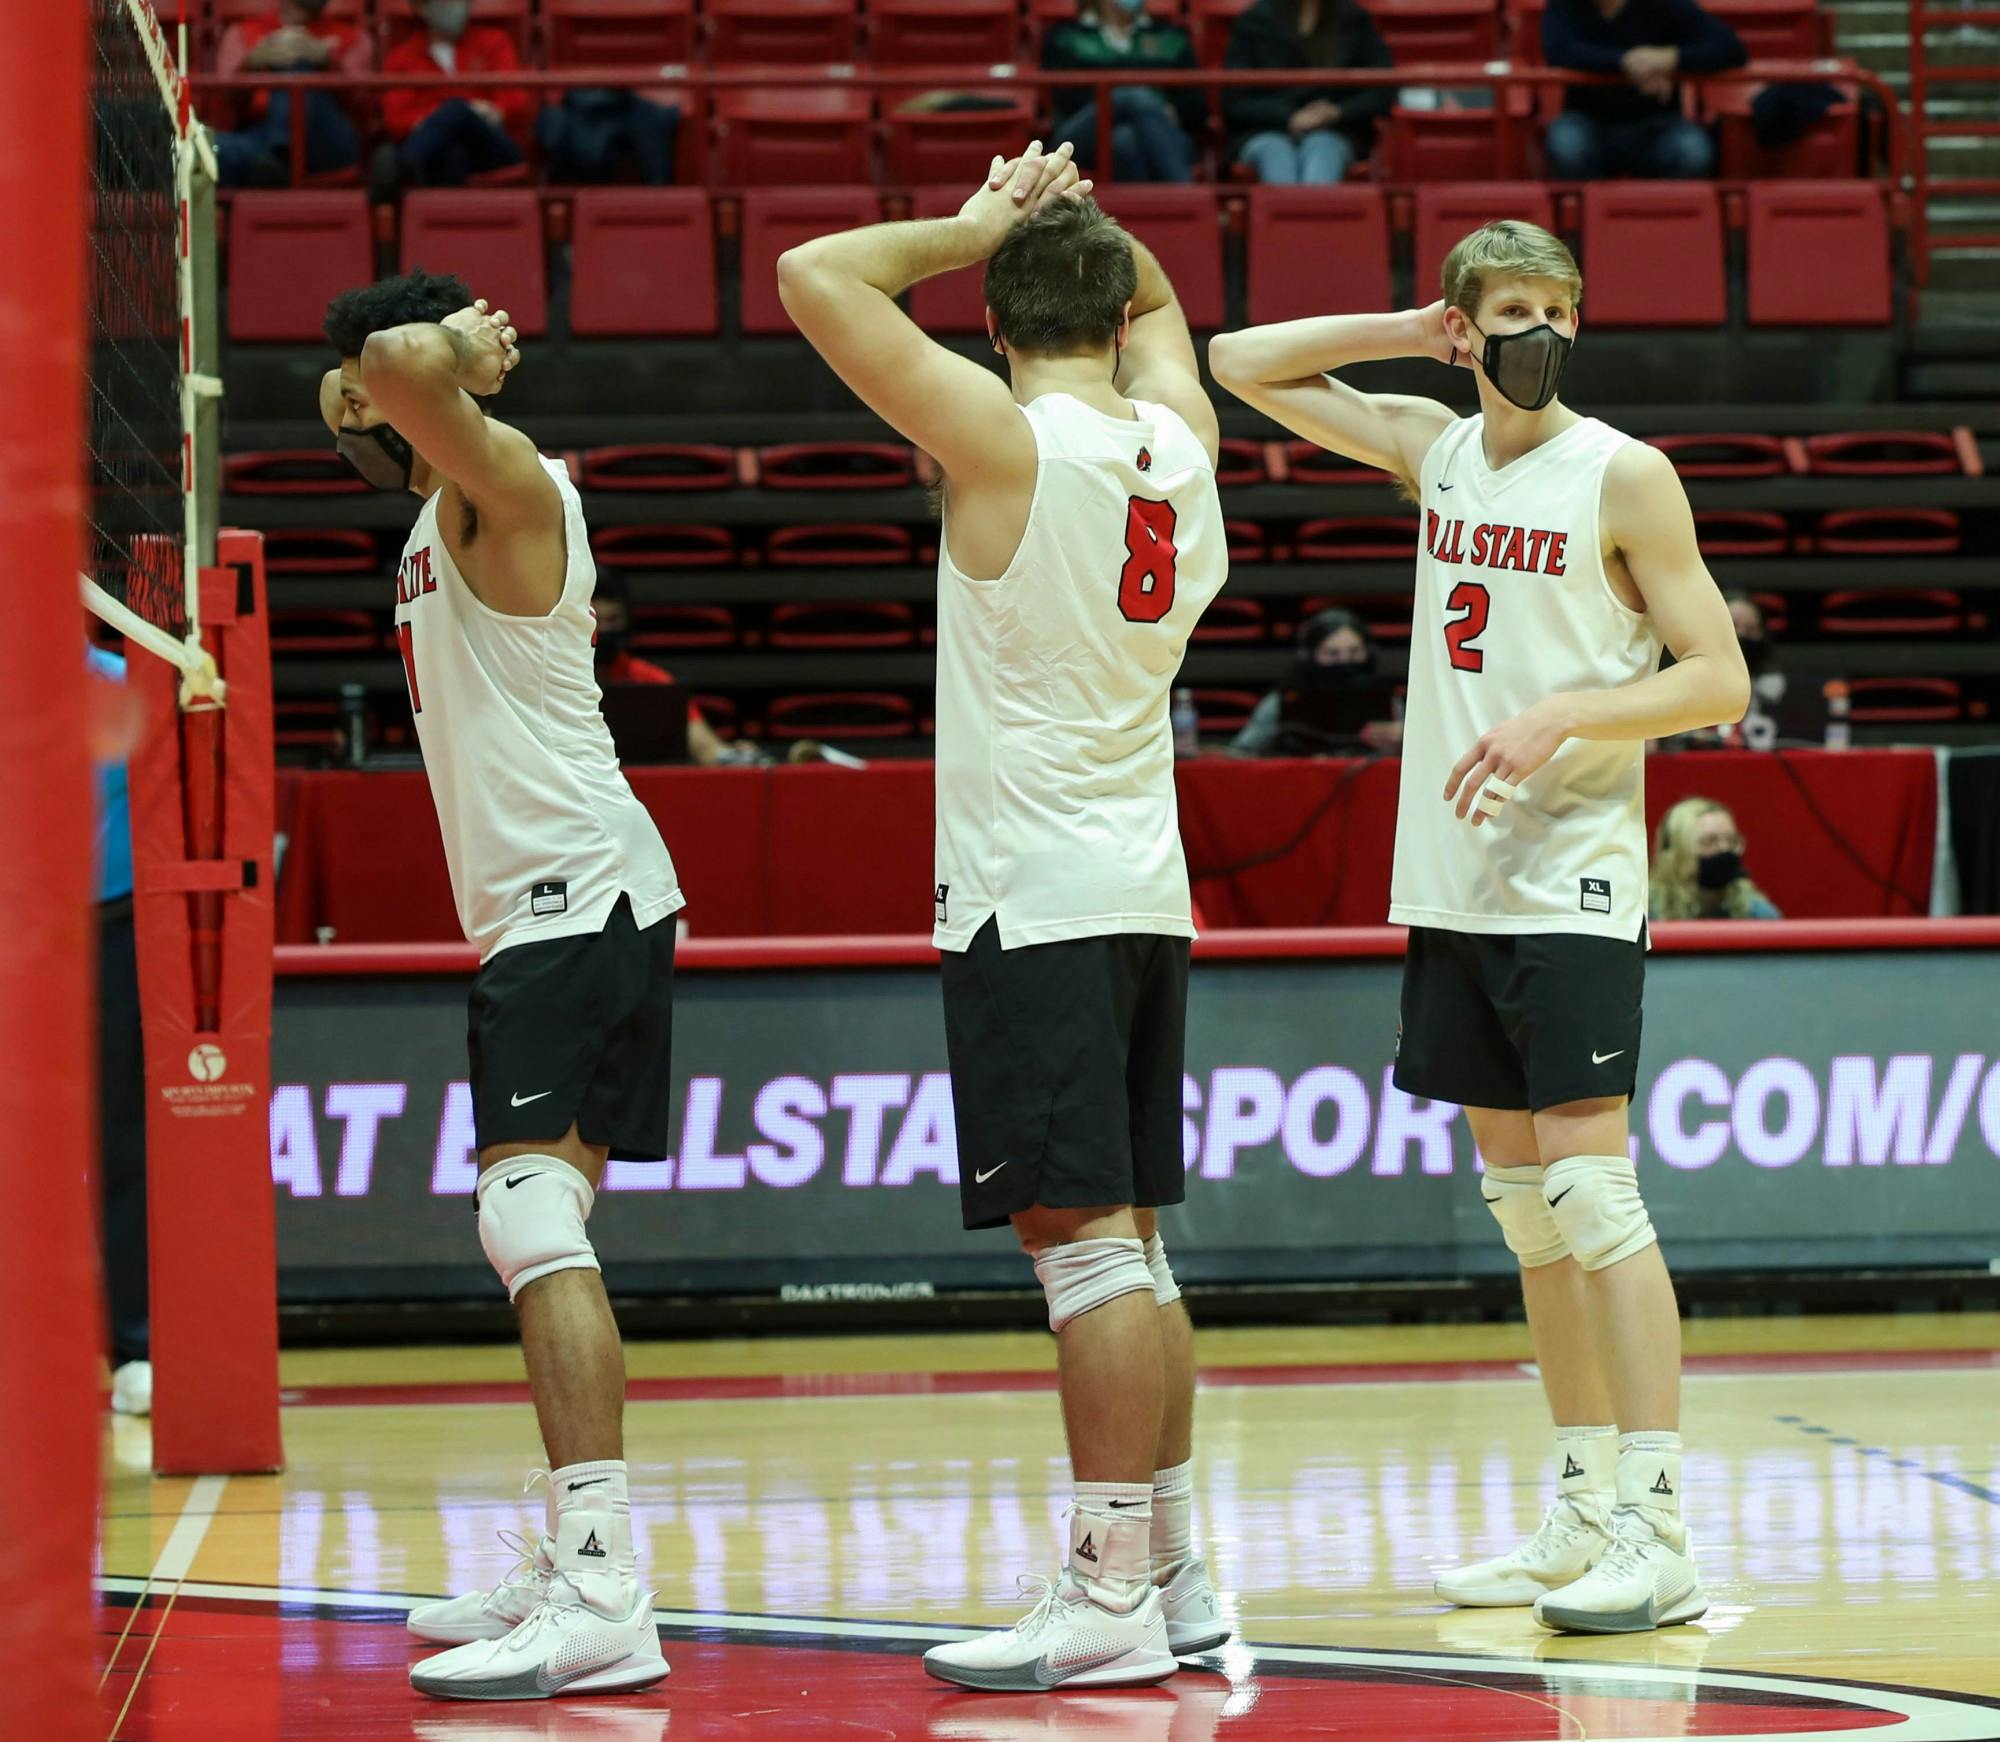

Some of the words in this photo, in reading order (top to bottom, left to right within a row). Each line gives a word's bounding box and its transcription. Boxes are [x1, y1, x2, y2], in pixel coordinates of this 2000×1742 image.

[1117, 495, 1178, 623] 8
[1471, 524, 1567, 576] STATE
[1444, 582, 1490, 673] 2
[543, 885, 553, 894] L
[1588, 880, 1604, 893] XL
[269, 1082, 408, 1197] AT
